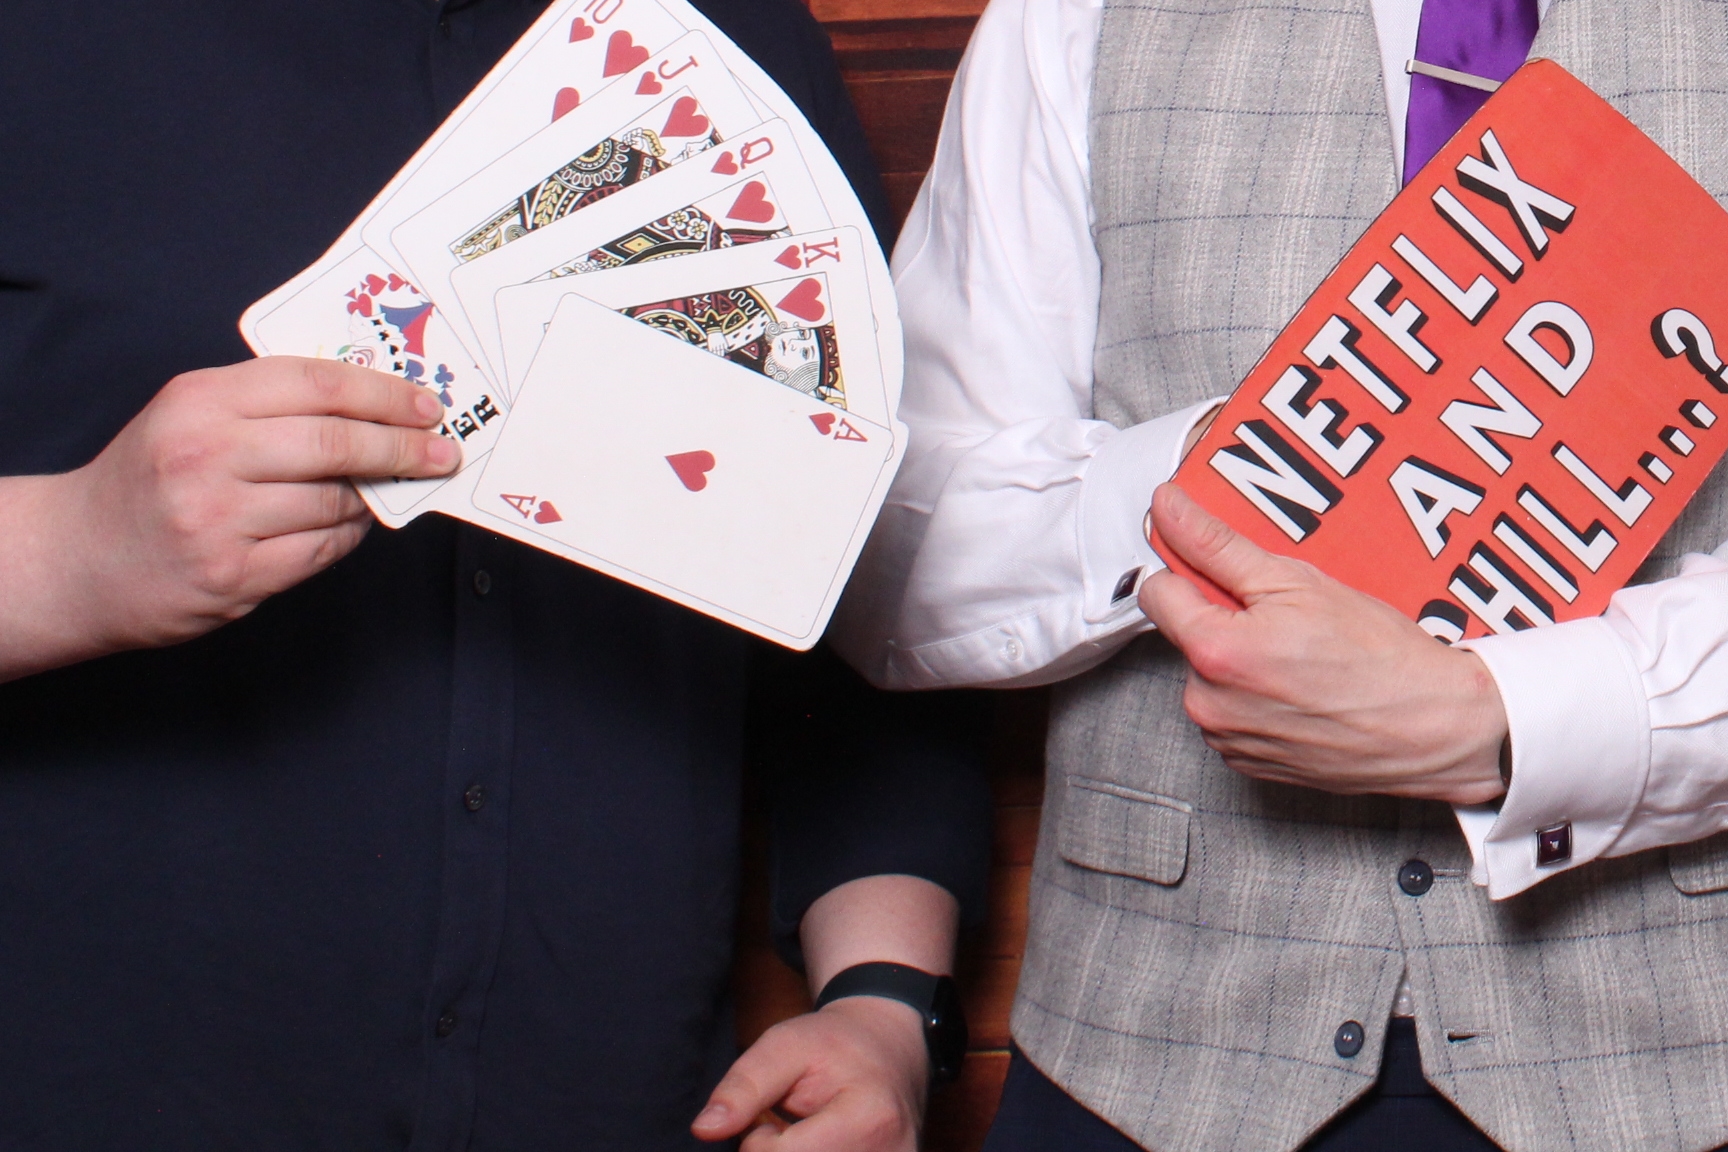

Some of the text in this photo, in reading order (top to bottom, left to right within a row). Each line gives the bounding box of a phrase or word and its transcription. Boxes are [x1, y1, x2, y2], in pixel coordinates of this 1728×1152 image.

[657, 55, 699, 81] J
[739, 136, 774, 170] Q
[802, 236, 841, 268] K
[1209, 127, 1577, 544] NETFLIX
[834, 418, 868, 444] A
[1388, 301, 1595, 560] AND
[500, 493, 537, 519] A
